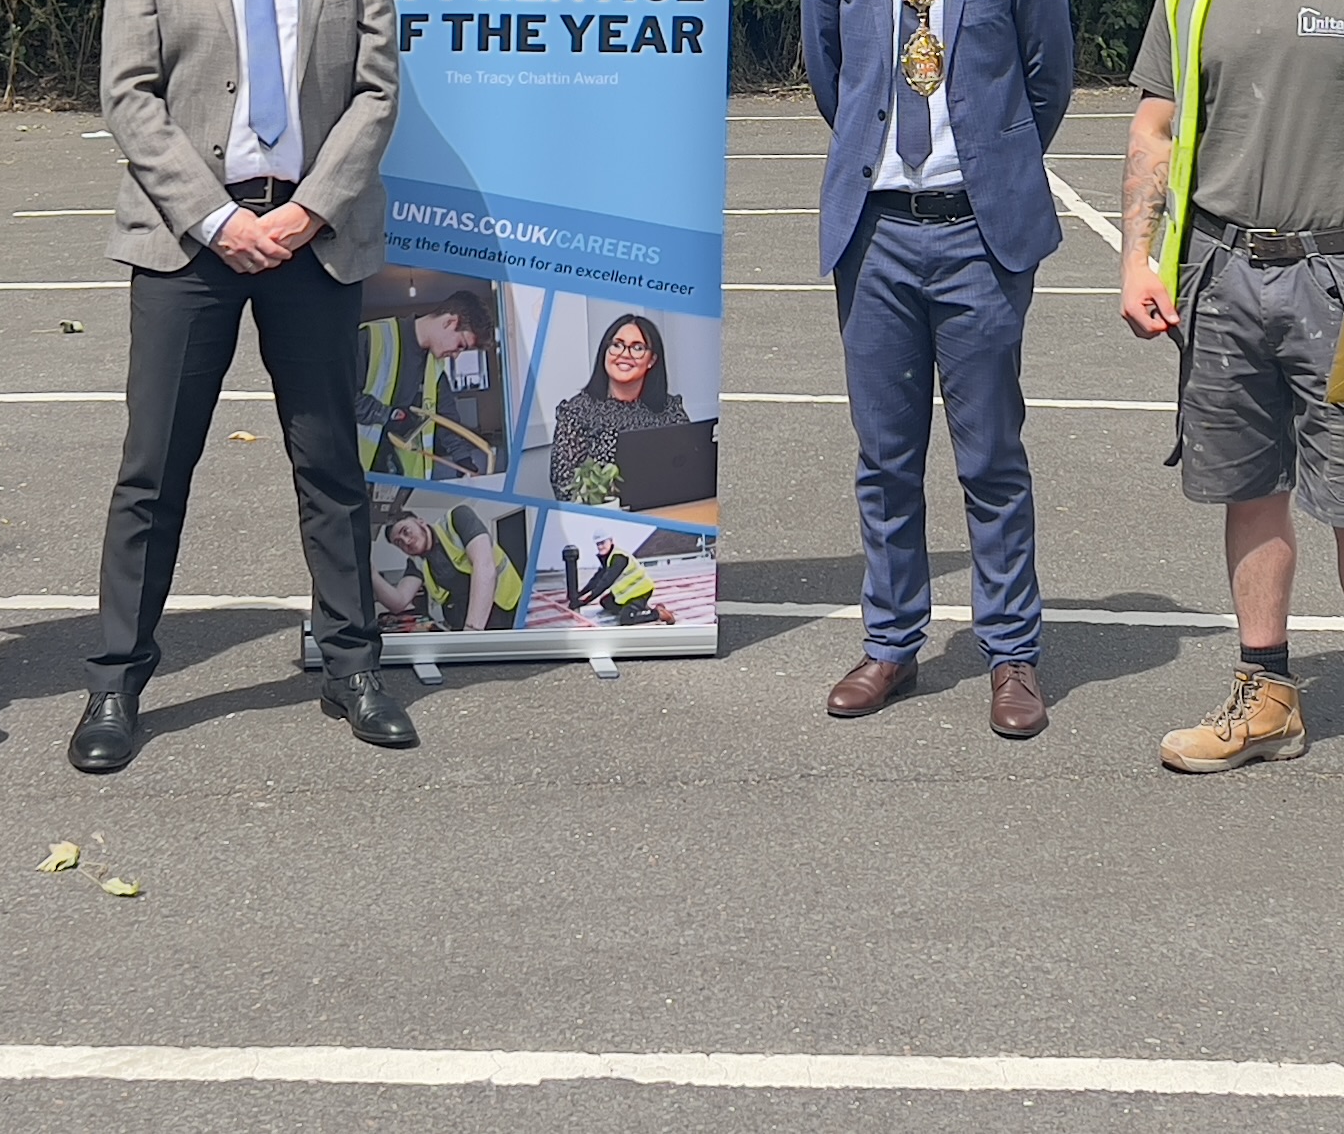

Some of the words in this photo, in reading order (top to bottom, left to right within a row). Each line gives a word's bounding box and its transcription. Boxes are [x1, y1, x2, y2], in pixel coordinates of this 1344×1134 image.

[399, 13, 429, 52] F
[441, 13, 547, 52] THE
[559, 14, 704, 54] YEAR
[445, 70, 472, 84] The
[476, 71, 514, 87] Tracy
[518, 71, 570, 85] Chattin
[574, 71, 619, 86] Award
[416, 236, 440, 252] the
[444, 239, 526, 267] foundation
[531, 255, 552, 271] for
[554, 263, 572, 274] an
[576, 266, 644, 287] excellent
[647, 278, 695, 296] career
